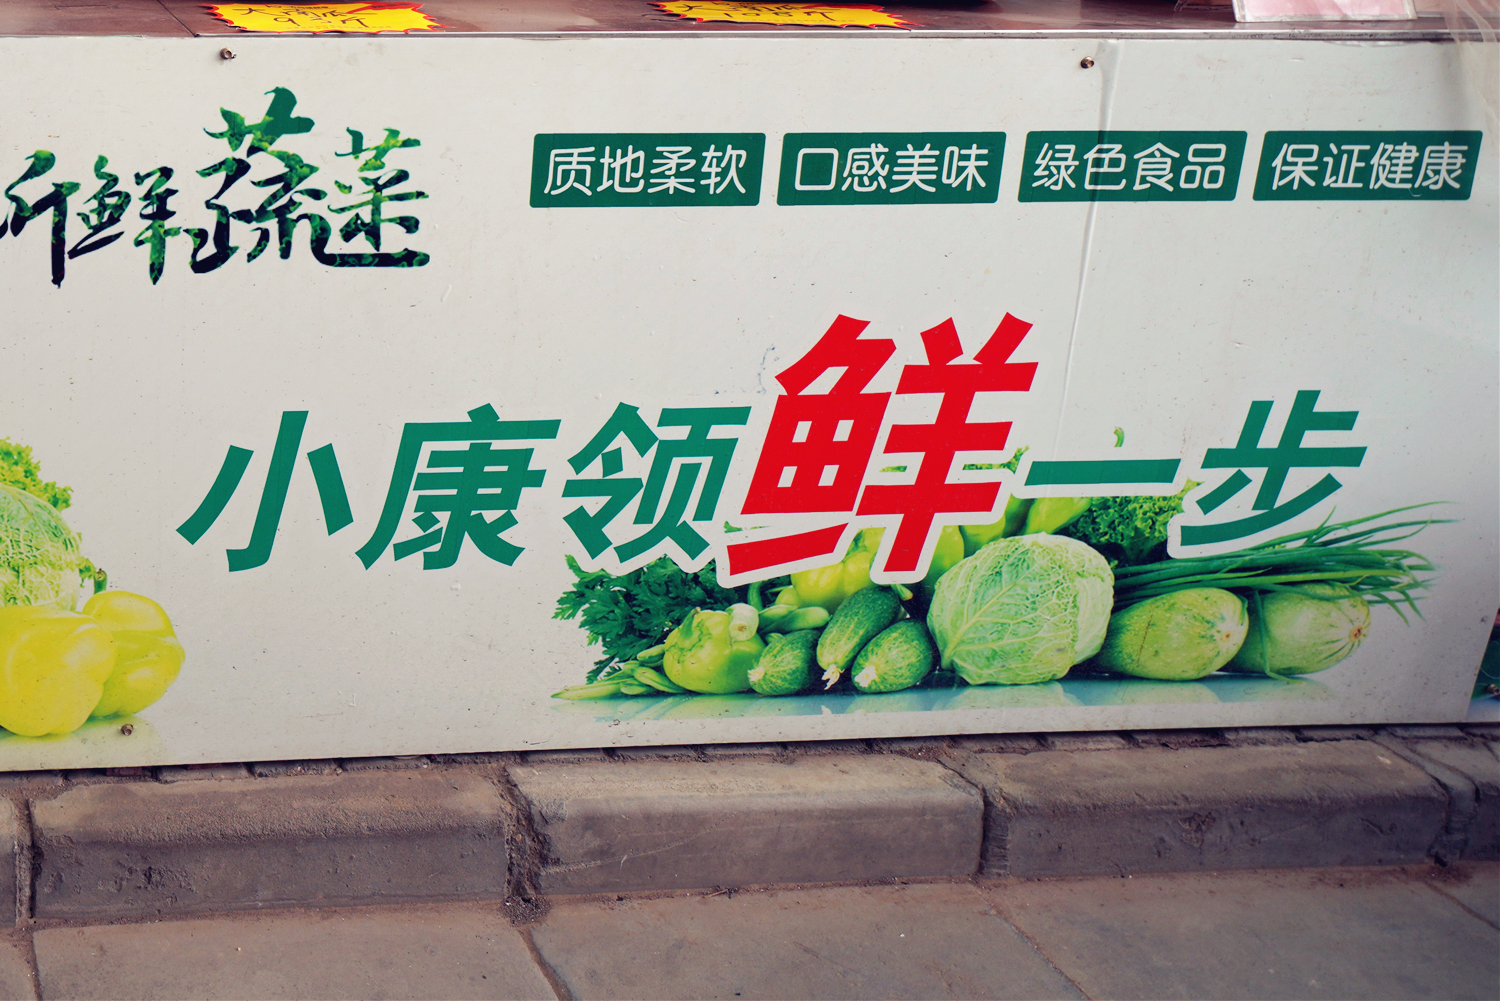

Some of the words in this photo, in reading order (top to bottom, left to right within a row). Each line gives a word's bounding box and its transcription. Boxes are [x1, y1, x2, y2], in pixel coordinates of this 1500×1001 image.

[542, 143, 749, 197] 质地柔软
[794, 141, 991, 194] 口感美味
[1032, 141, 1227, 193] 绿色食品
[1270, 140, 1467, 192] 保证健康
